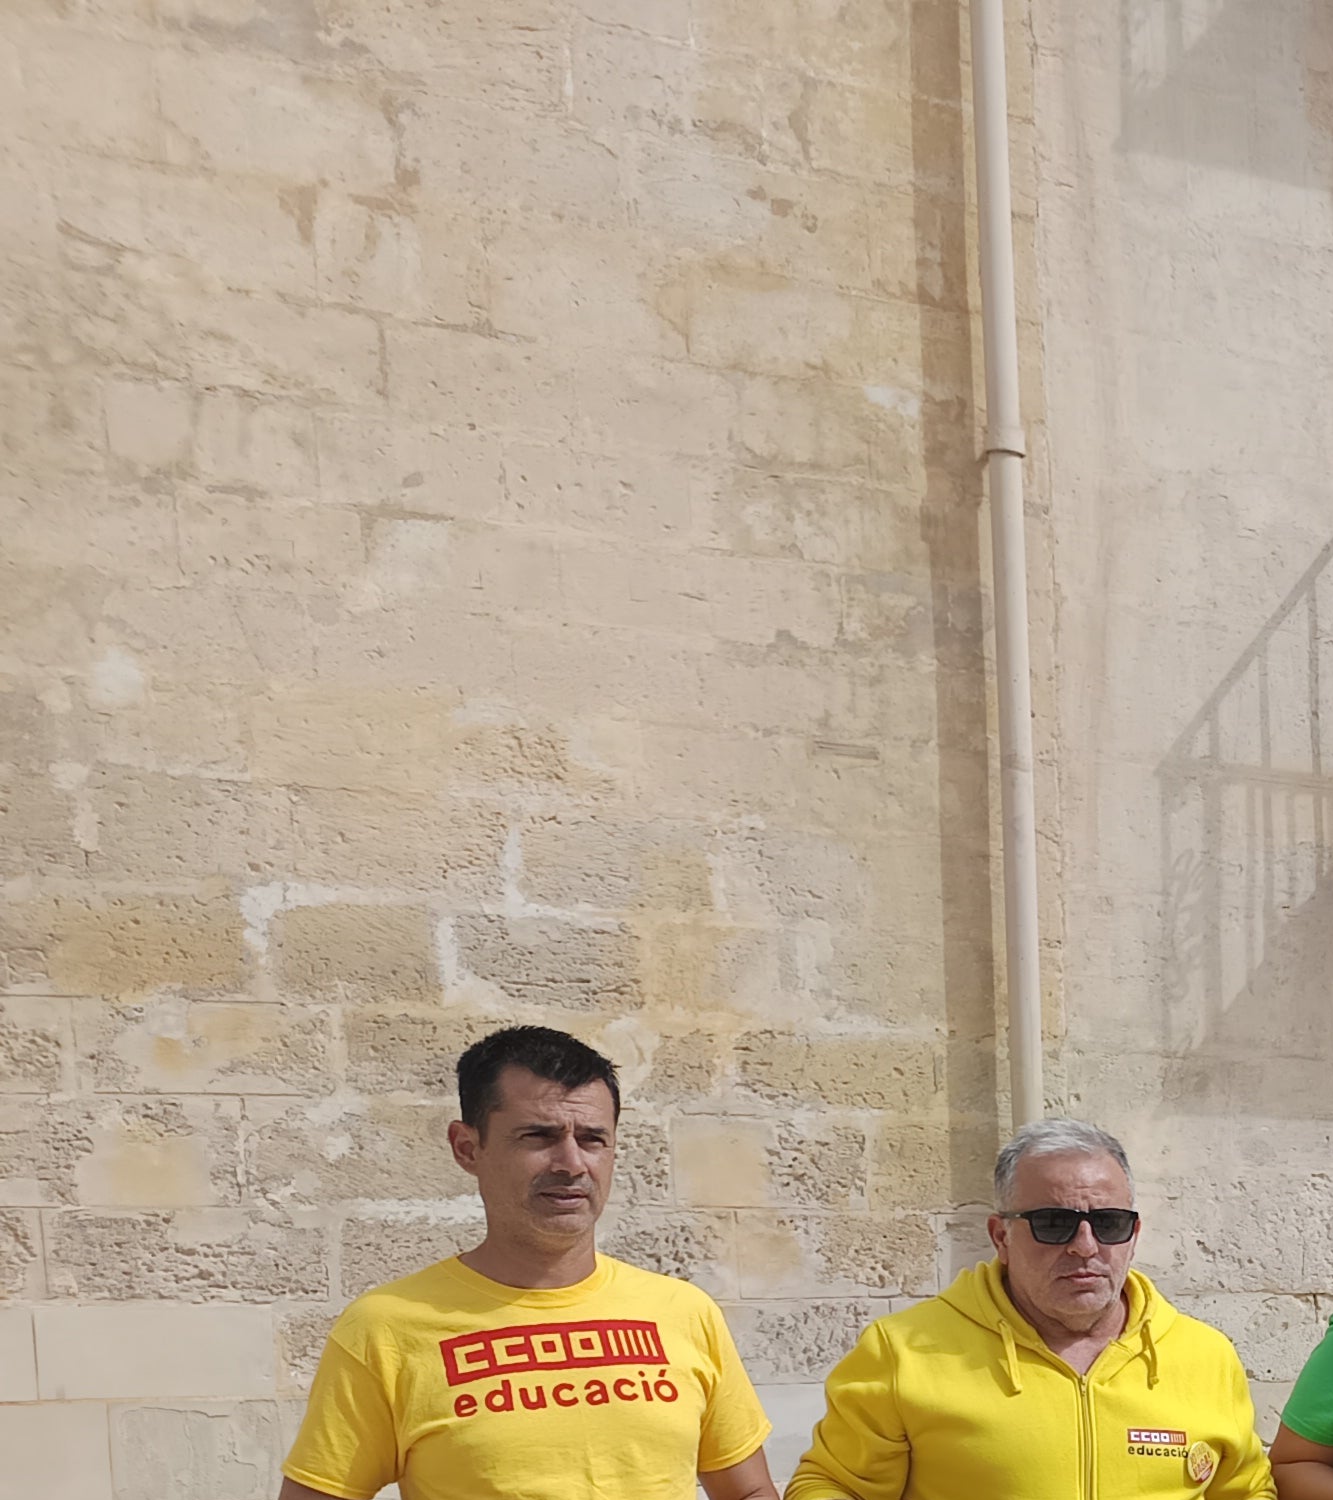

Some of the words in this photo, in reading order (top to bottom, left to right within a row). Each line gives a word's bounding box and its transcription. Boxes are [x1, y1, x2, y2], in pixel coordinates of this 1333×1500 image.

[453, 1329, 604, 1374] CCOO
[454, 1368, 679, 1418] educació
[1130, 1431, 1170, 1443] CCOO
[1128, 1445, 1189, 1459] educació
